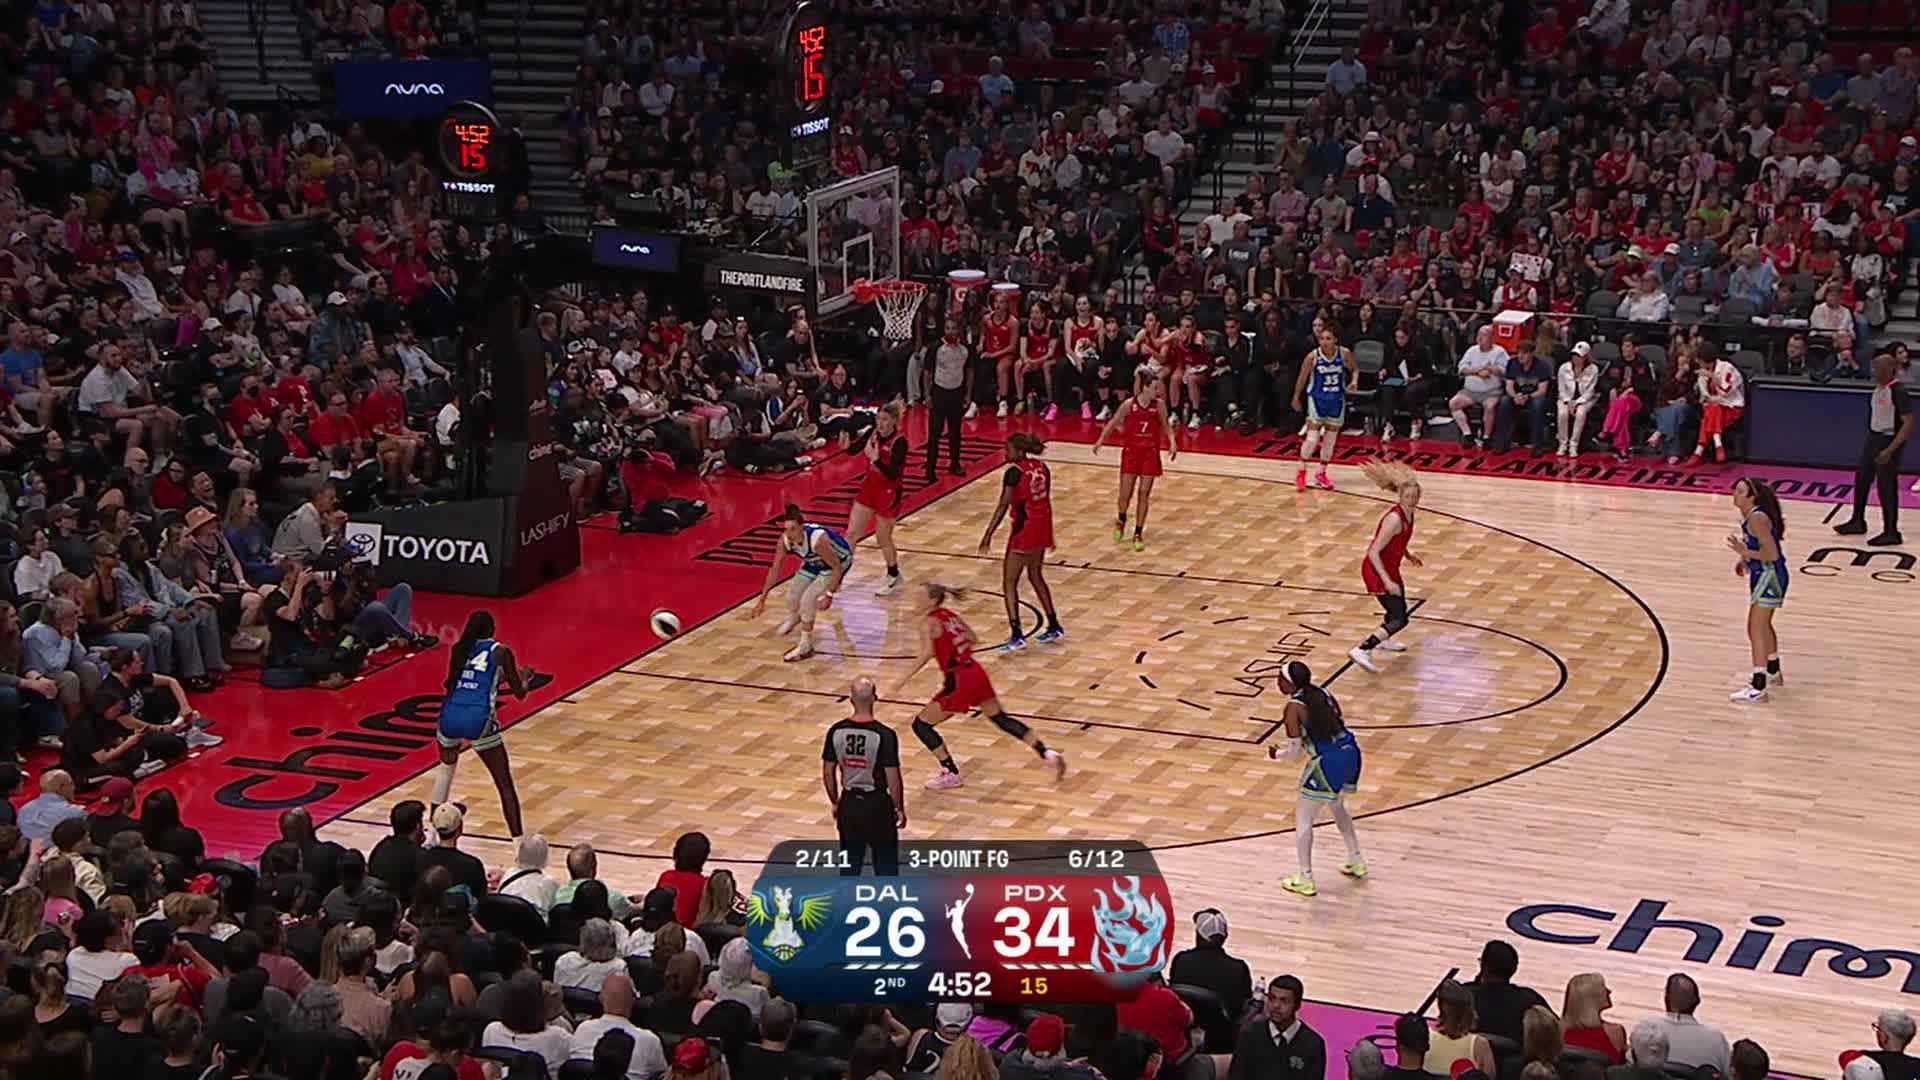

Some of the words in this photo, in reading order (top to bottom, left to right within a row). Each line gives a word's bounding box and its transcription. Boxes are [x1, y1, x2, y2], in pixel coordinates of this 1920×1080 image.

[804, 52, 825, 100] 15
[462, 144, 486, 168] 15
[457, 182, 495, 193] TISSOT
[1139, 421, 1148, 432] 7
[521, 512, 569, 546] LASHIFY
[384, 535, 489, 565] TOYOTA
[845, 733, 866, 757] 32
